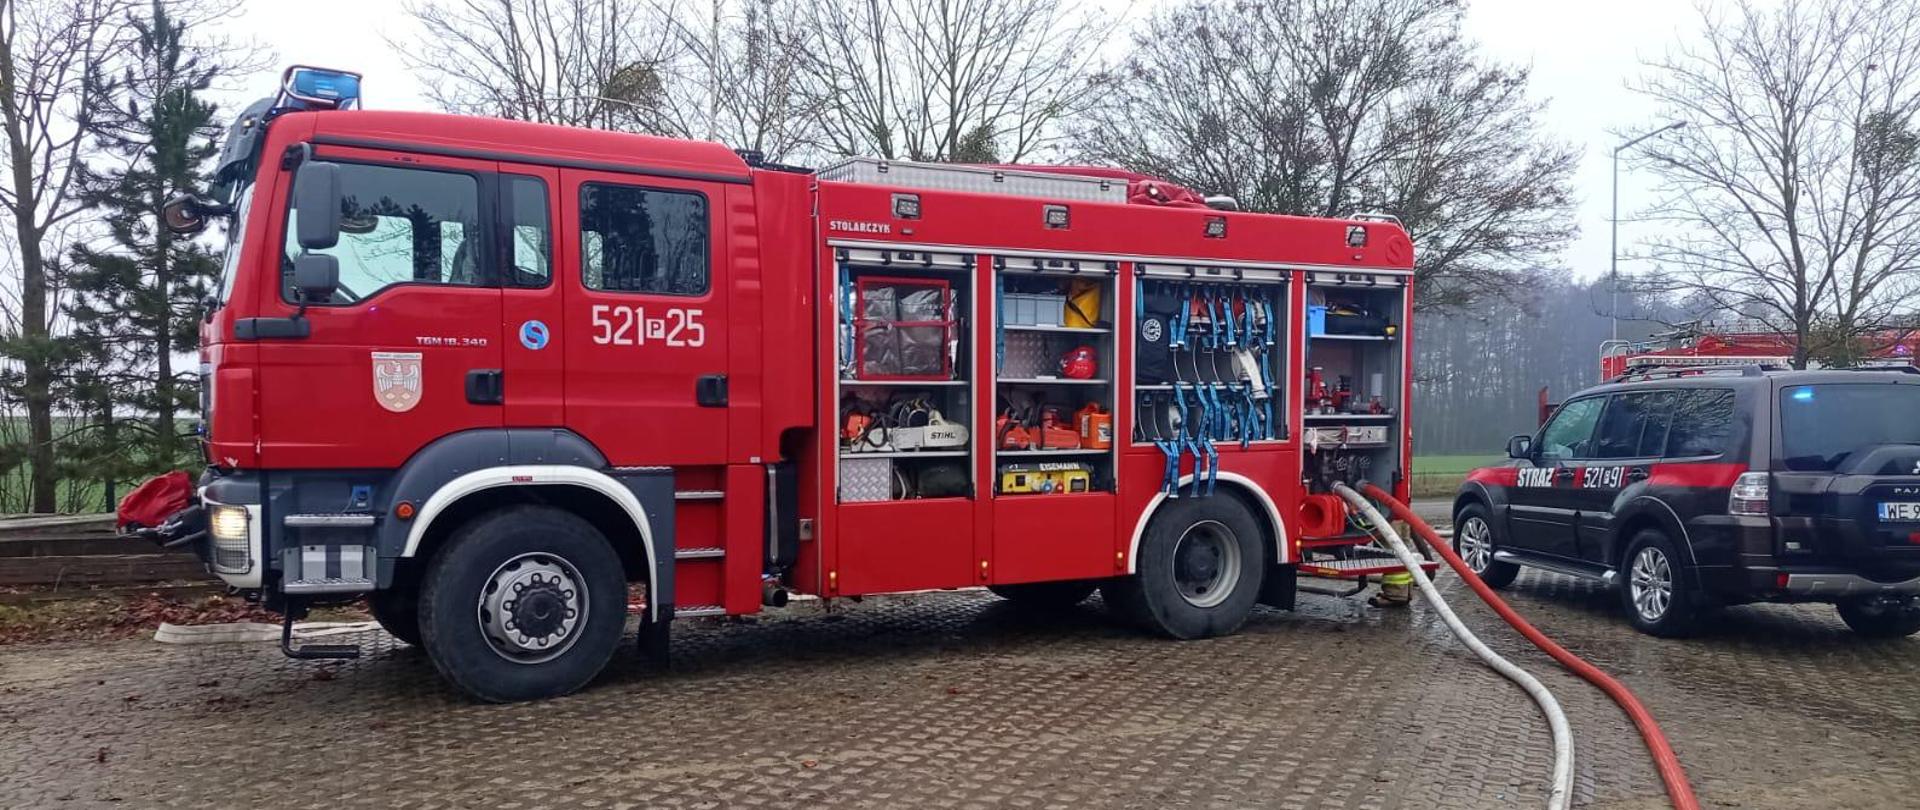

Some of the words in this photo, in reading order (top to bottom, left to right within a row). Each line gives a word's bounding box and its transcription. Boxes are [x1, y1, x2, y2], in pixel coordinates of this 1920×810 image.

[830, 220, 891, 233] STOLARCZYK
[416, 336, 442, 345] TGM
[930, 431, 956, 440] STIHL
[1039, 462, 1080, 472] EISEMANN
[1887, 504, 1908, 519] WE
